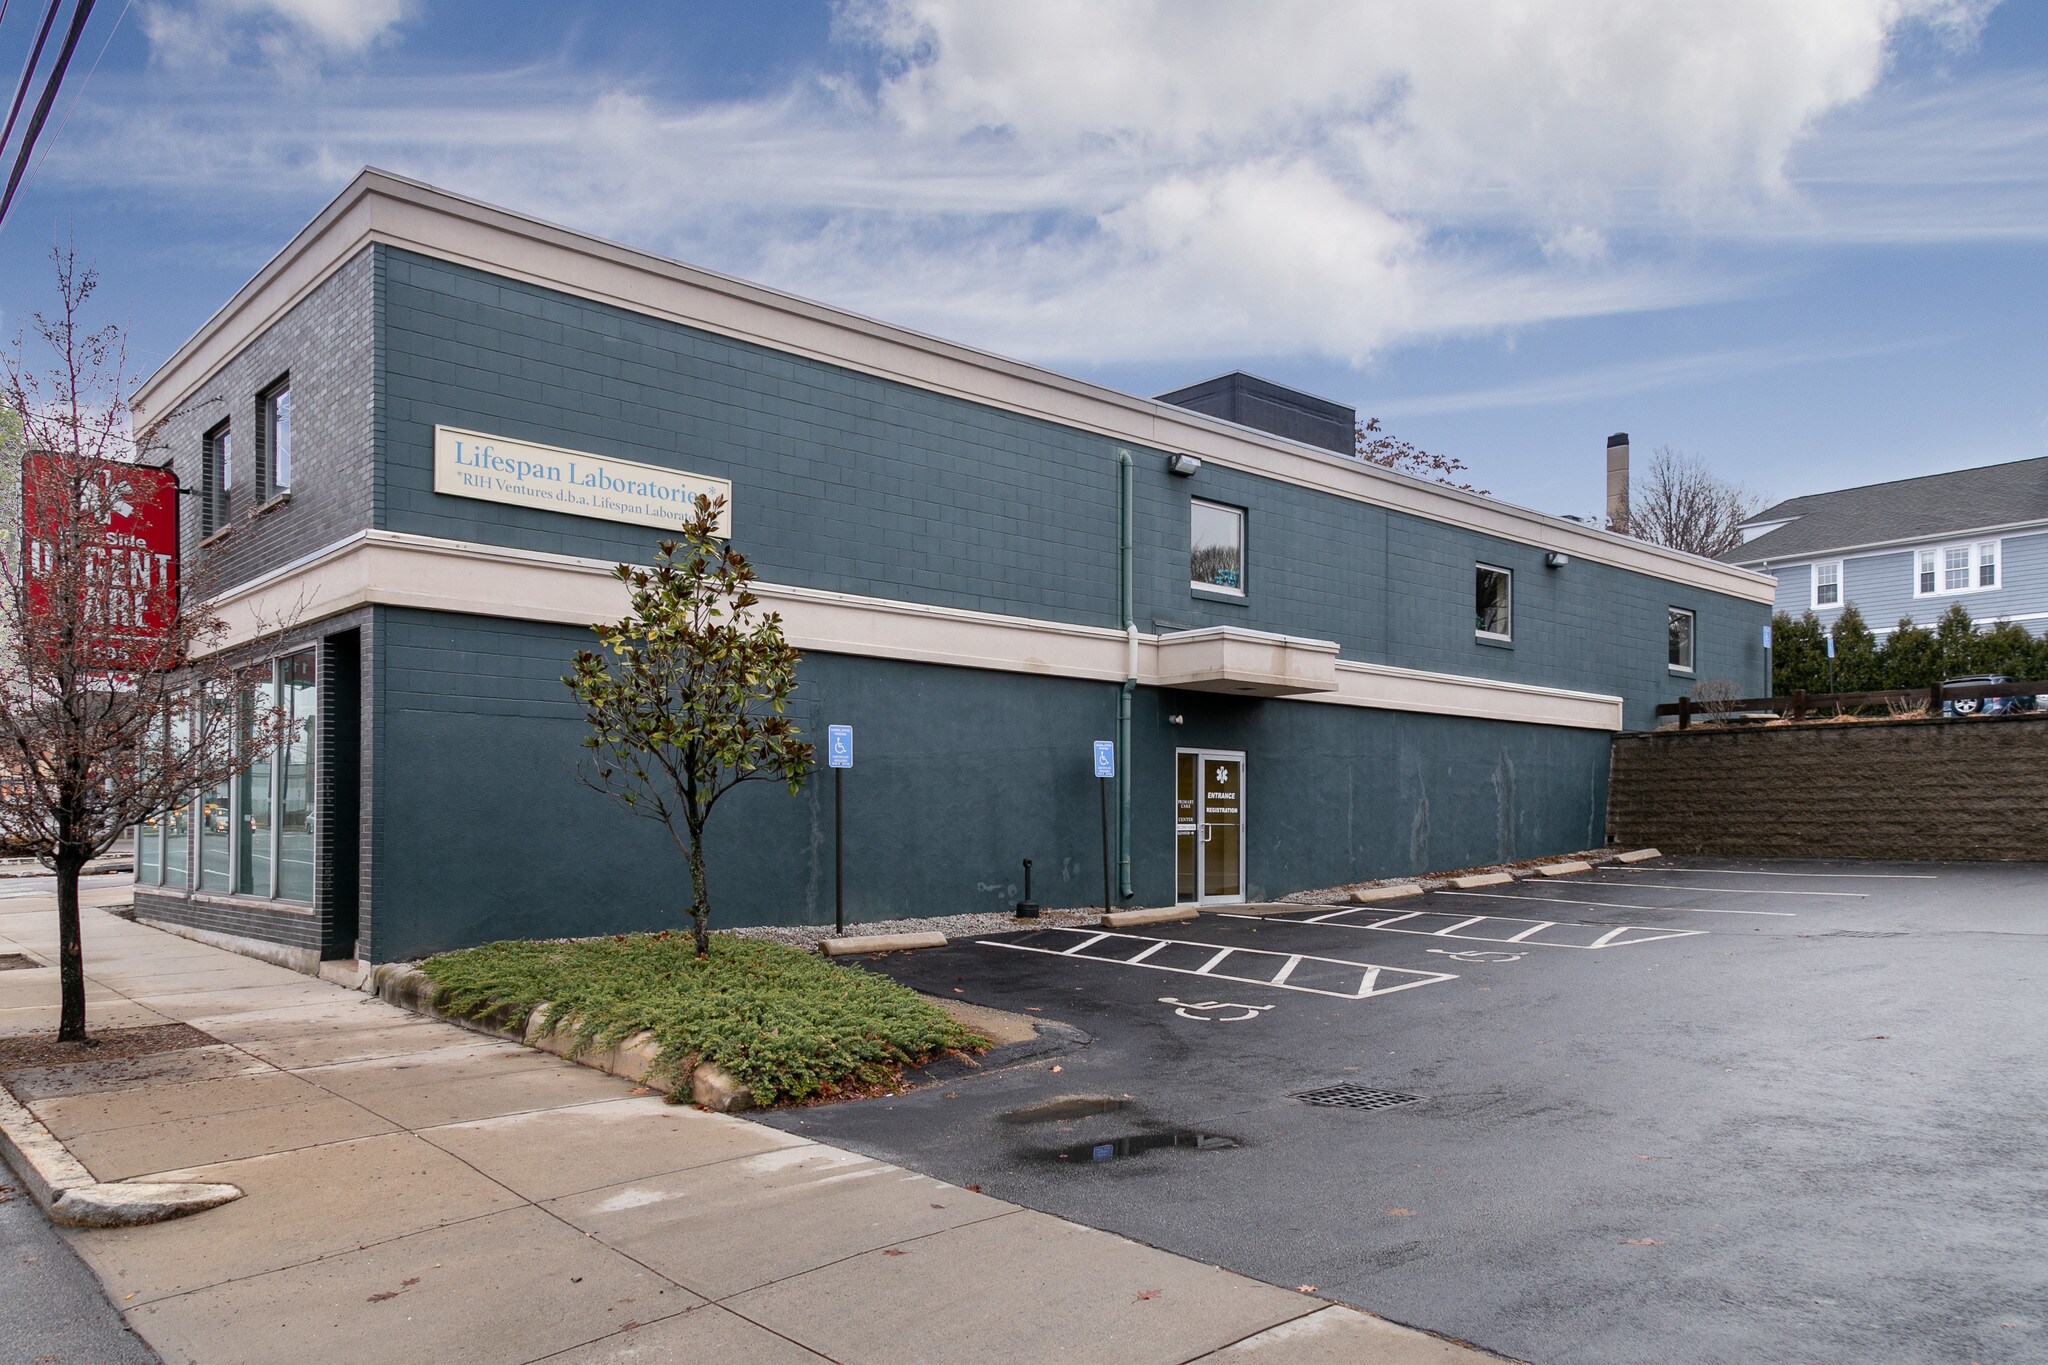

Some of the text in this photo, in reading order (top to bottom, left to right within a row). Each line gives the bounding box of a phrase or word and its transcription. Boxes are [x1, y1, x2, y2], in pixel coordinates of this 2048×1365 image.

[455, 440, 716, 507] Lifespan Laboratorie
[496, 478, 553, 500] Ventures
[556, 490, 589, 505] d.b.a.
[592, 495, 642, 515] Lifespan
[646, 504, 706, 525] Laborato
[105, 531, 147, 548] Side
[31, 540, 172, 591] UGENT
[58, 580, 149, 628] ARE
[1207, 792, 1236, 800] ENTRANCE
